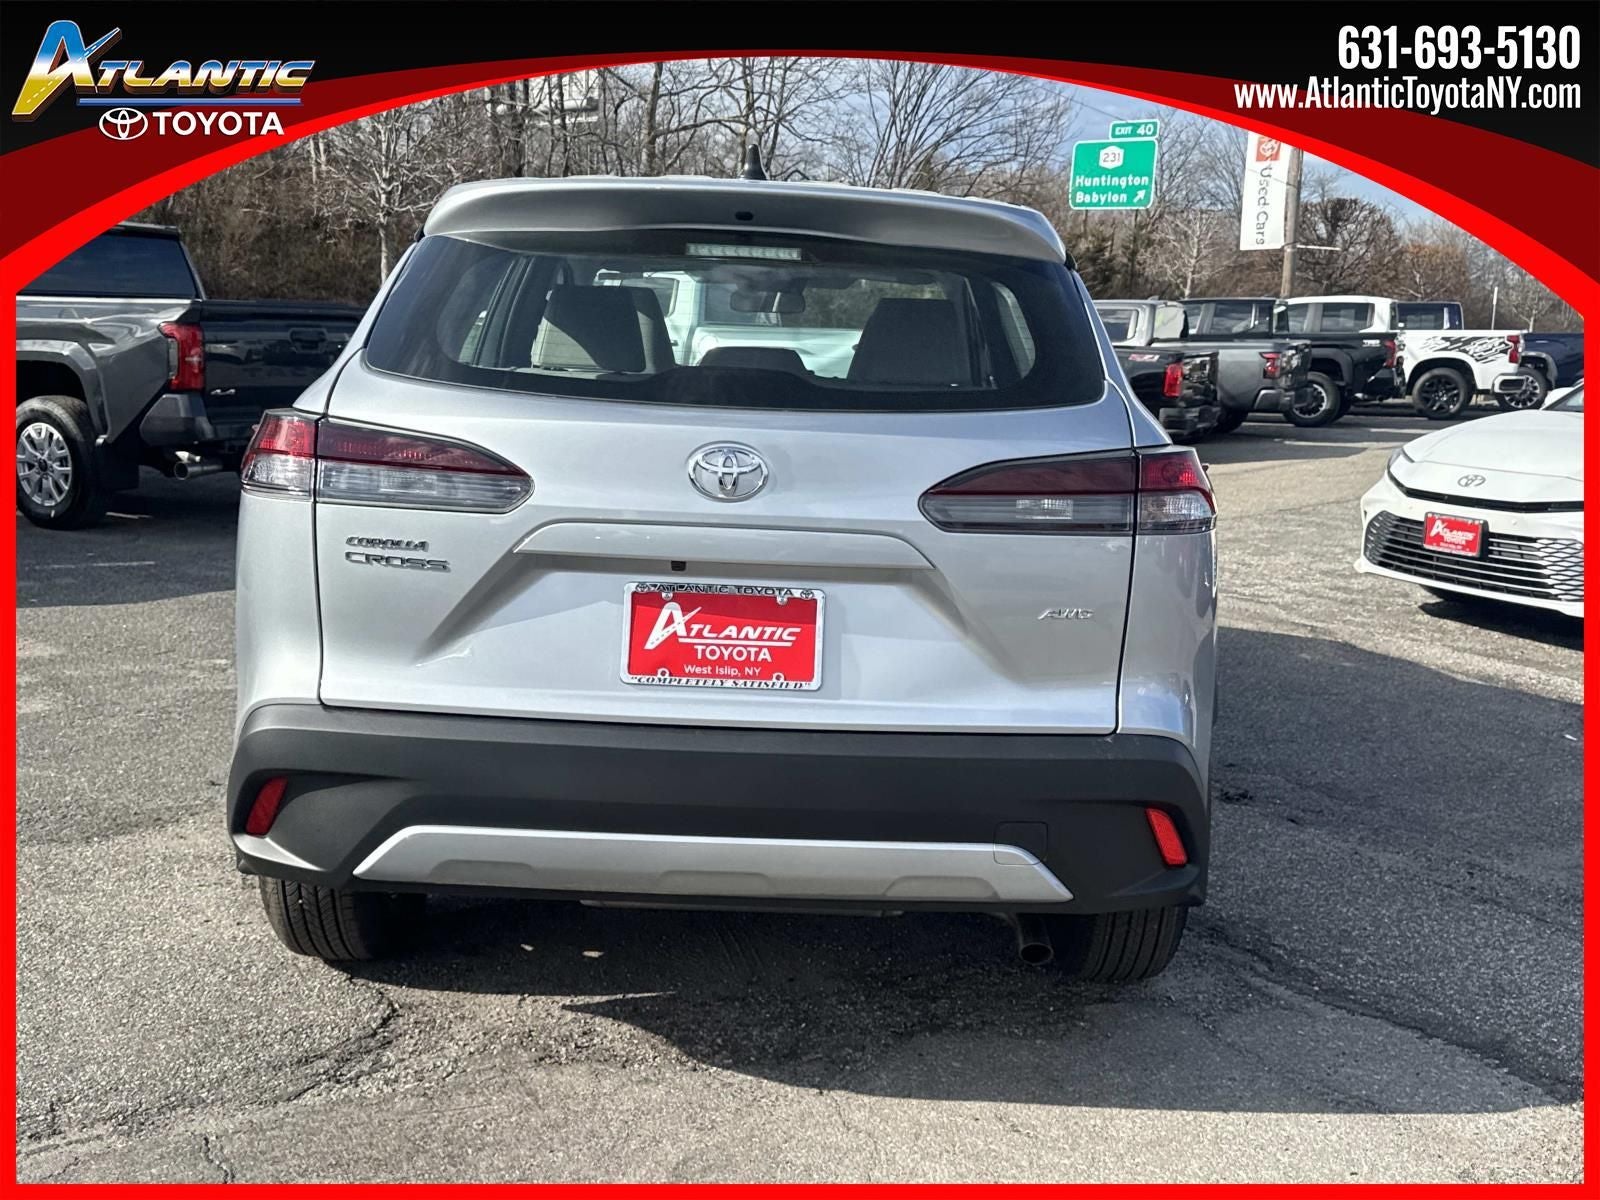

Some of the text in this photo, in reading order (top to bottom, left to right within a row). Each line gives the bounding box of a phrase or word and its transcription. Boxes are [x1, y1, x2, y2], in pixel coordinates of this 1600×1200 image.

[1115, 124, 1154, 135] EXIT 40
[1102, 152, 1121, 163] 231
[1075, 174, 1149, 189] Huntington
[1075, 191, 1127, 205] Babylon
[1255, 167, 1273, 245] Used Cars
[345, 536, 429, 552] COROLLA
[345, 551, 451, 572] CROSS
[657, 583, 794, 597] ATLANTIC TOYOTA
[644, 601, 802, 650] ATLANTIC
[694, 645, 772, 663] TOYOTA
[683, 664, 762, 677] West Islip, NY
